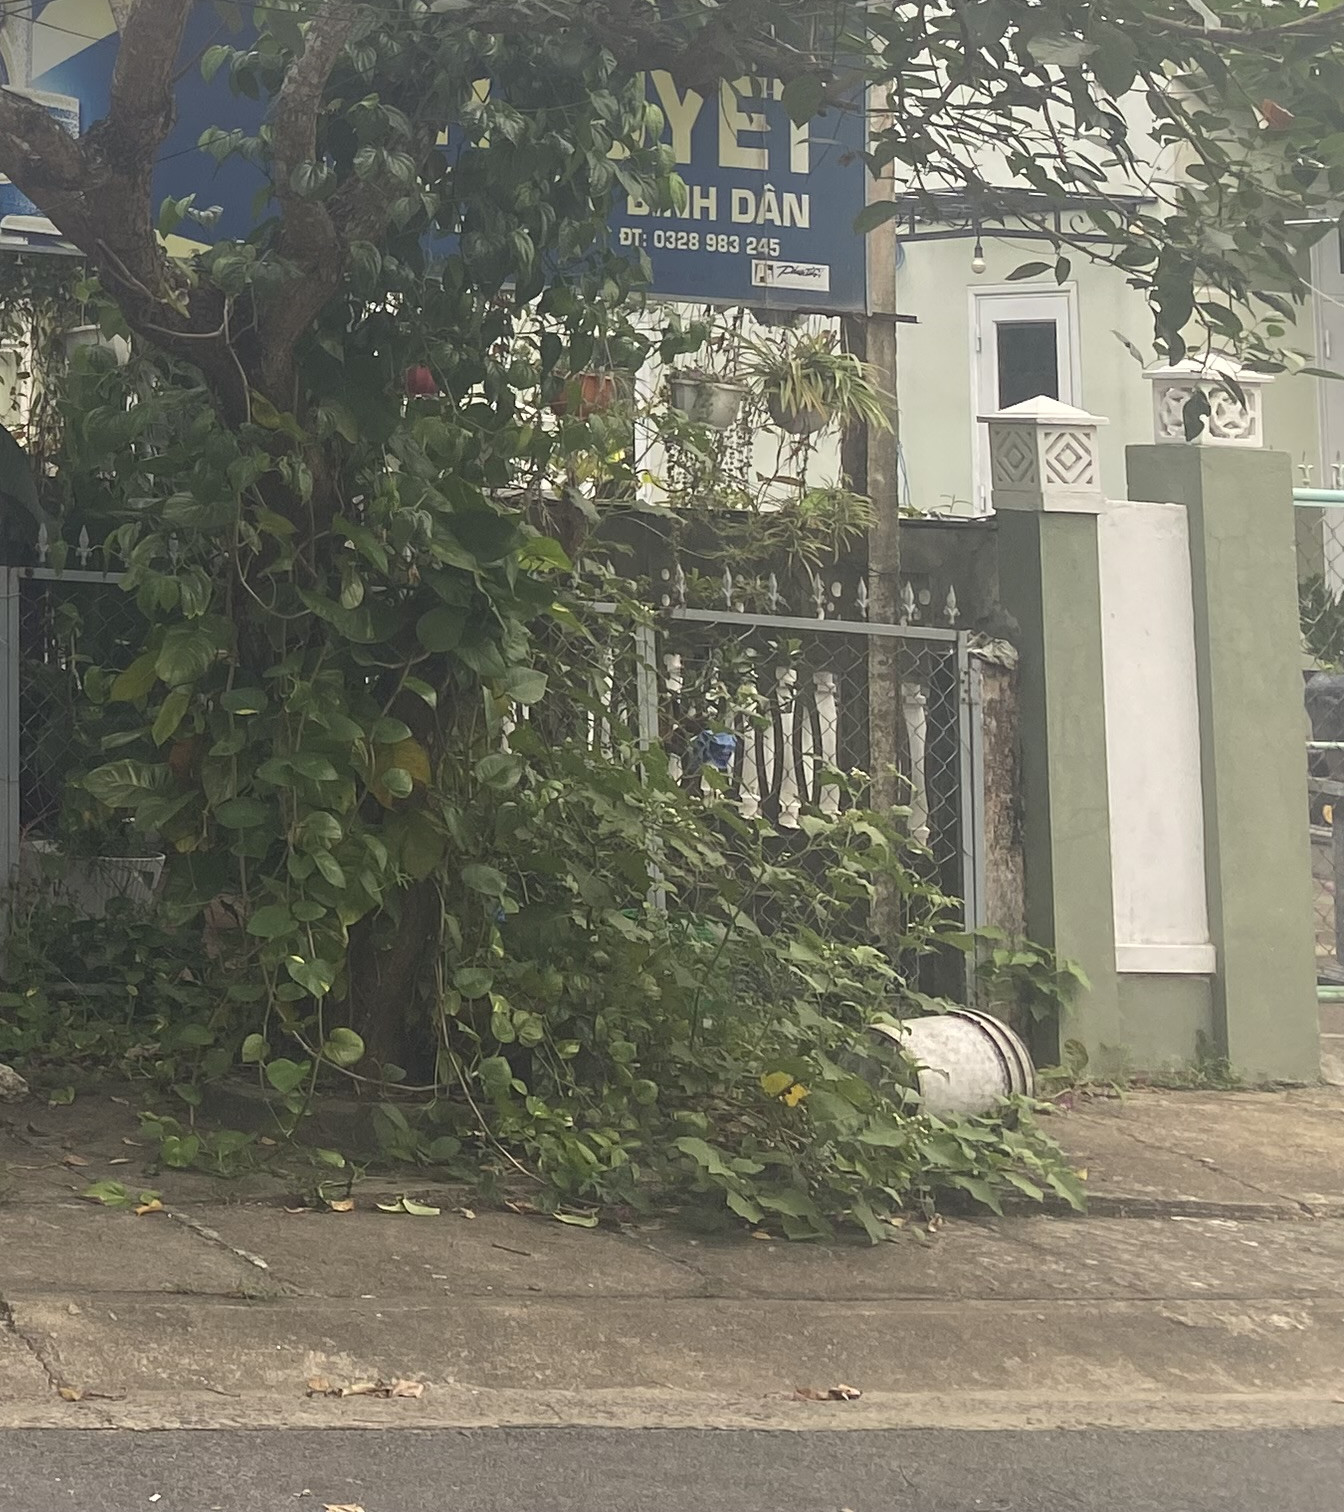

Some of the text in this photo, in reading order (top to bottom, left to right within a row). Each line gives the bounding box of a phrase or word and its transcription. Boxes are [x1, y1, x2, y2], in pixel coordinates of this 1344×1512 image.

[731, 183, 810, 229] DÂN
[619, 227, 781, 258] ĐT: 0328 983 245
